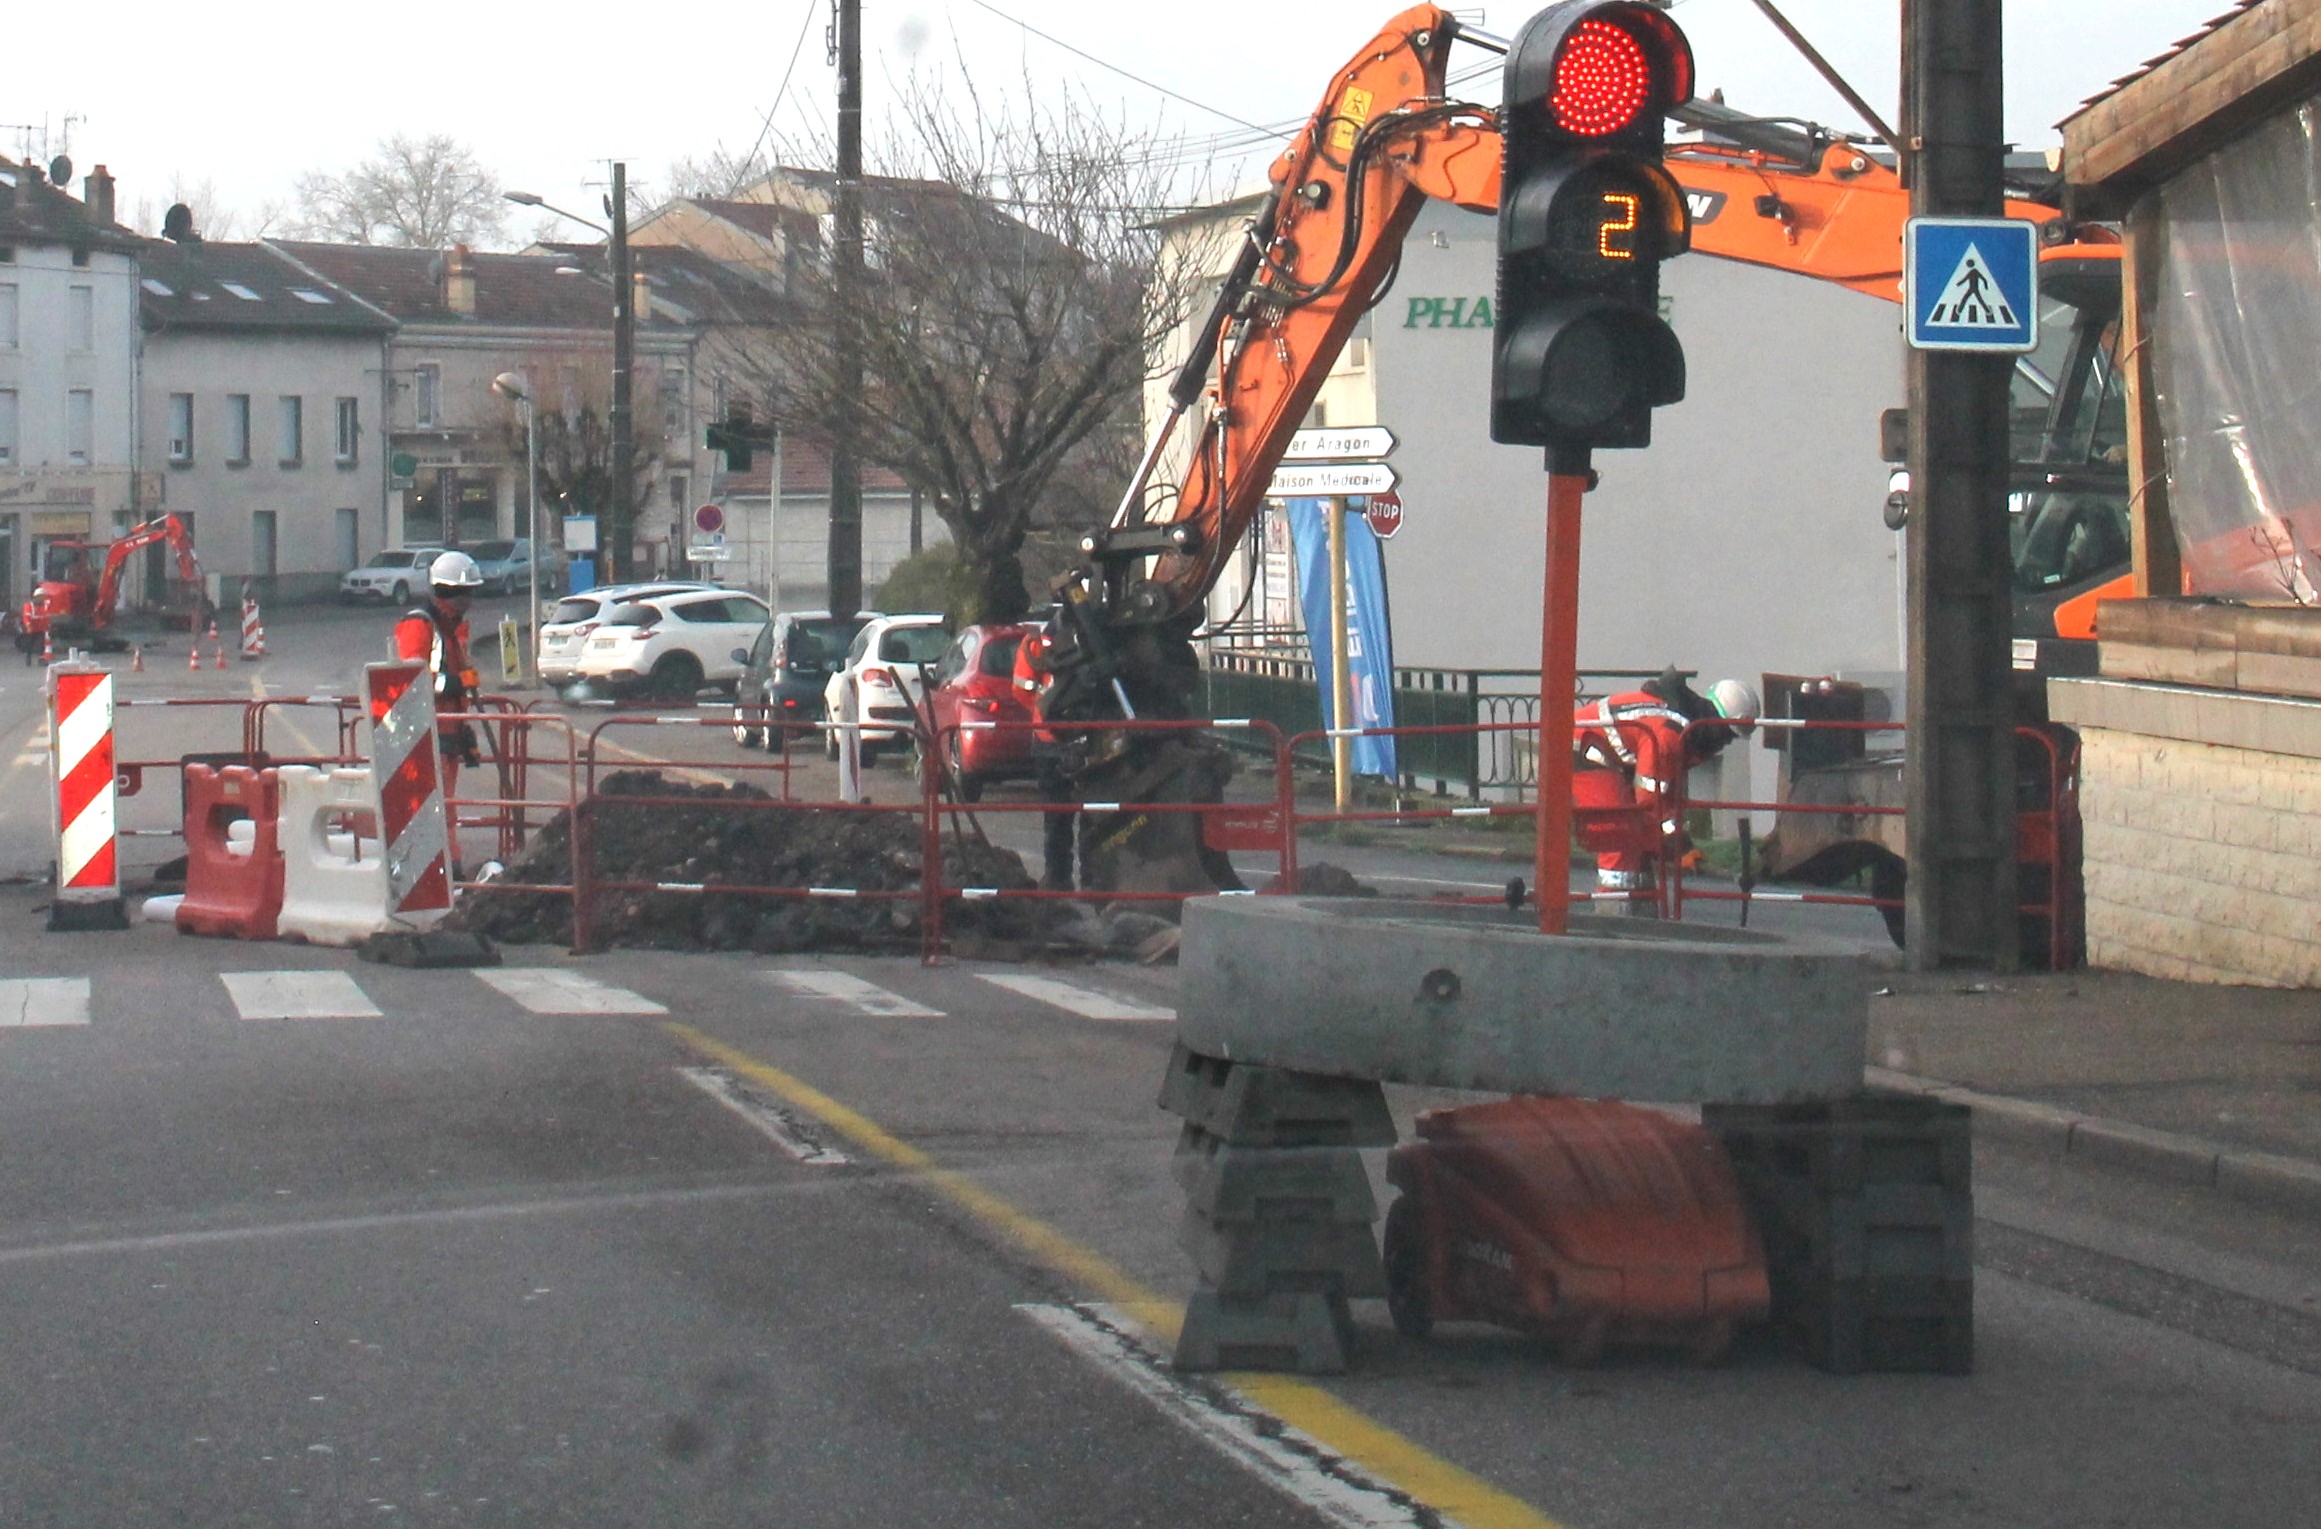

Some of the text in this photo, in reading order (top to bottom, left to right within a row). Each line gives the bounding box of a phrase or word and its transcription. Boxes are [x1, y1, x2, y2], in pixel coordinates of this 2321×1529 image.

[1600, 193, 1636, 258] 2
[1291, 436, 1370, 454] er Aragon
[1371, 501, 1400, 519] STOP
